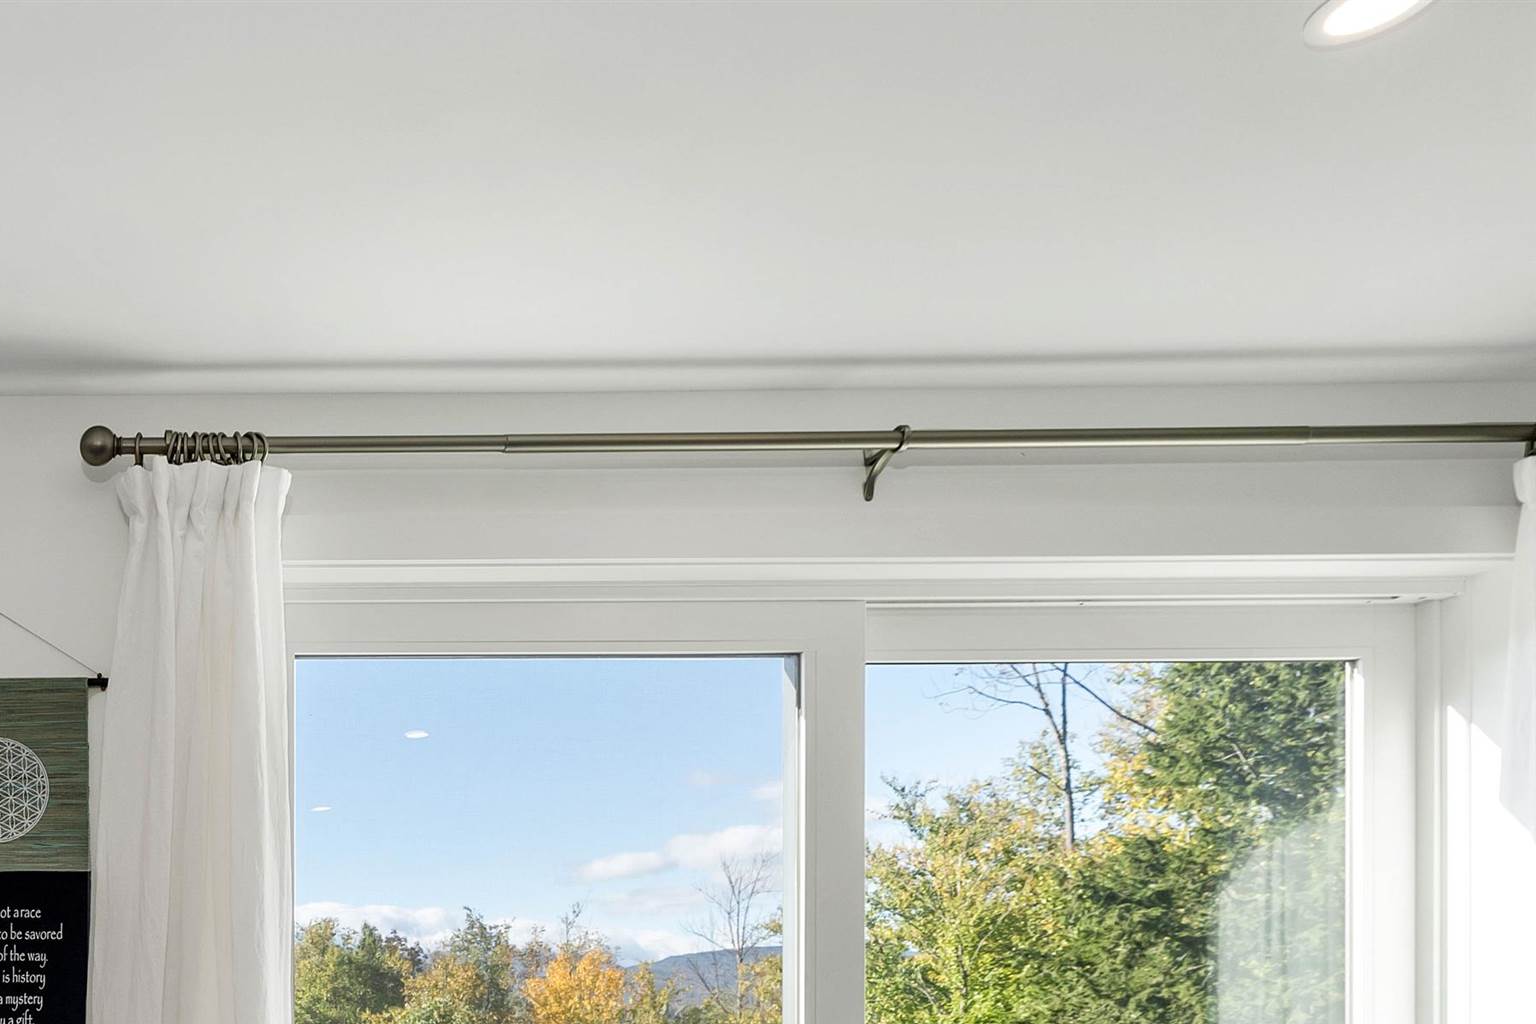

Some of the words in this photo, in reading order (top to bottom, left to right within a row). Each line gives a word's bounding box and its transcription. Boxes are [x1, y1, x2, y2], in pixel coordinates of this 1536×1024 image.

[13, 908, 20, 919] a
[20, 908, 42, 919] race
[10, 922, 23, 941] be
[24, 922, 64, 941] savored
[10, 944, 26, 962] the
[27, 952, 49, 969] way.
[2, 969, 11, 984] is
[12, 966, 46, 990] history
[5, 993, 44, 1012] mystery
